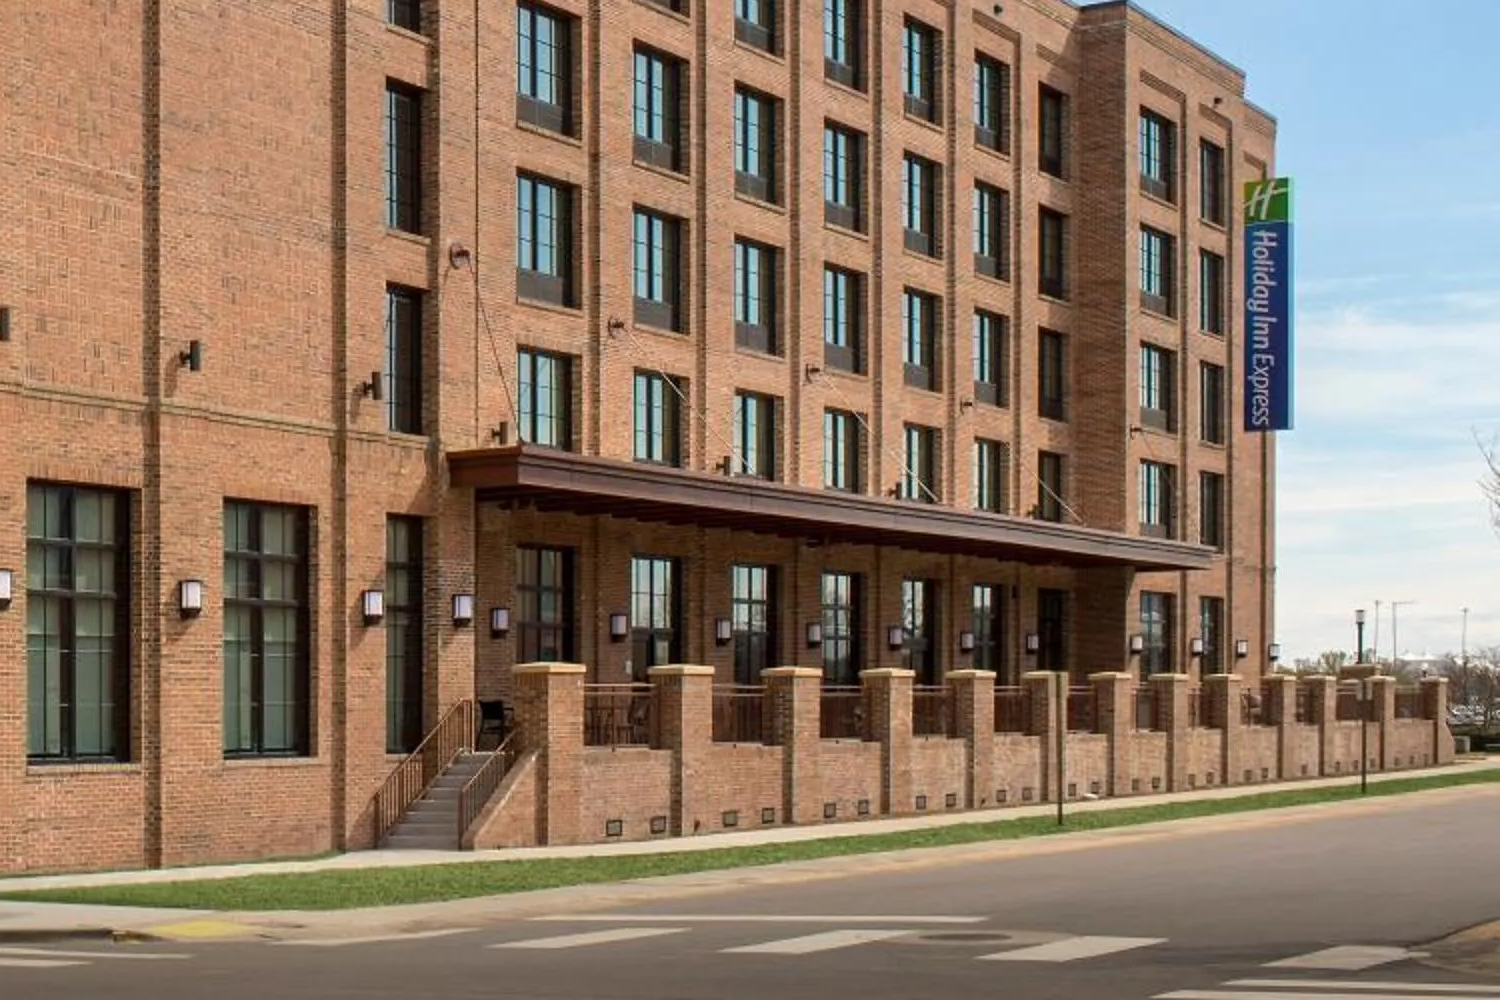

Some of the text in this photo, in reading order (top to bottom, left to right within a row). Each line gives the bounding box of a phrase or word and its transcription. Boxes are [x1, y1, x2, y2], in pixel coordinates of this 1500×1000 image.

[1246, 230, 1278, 426] Holiday Inn Express
